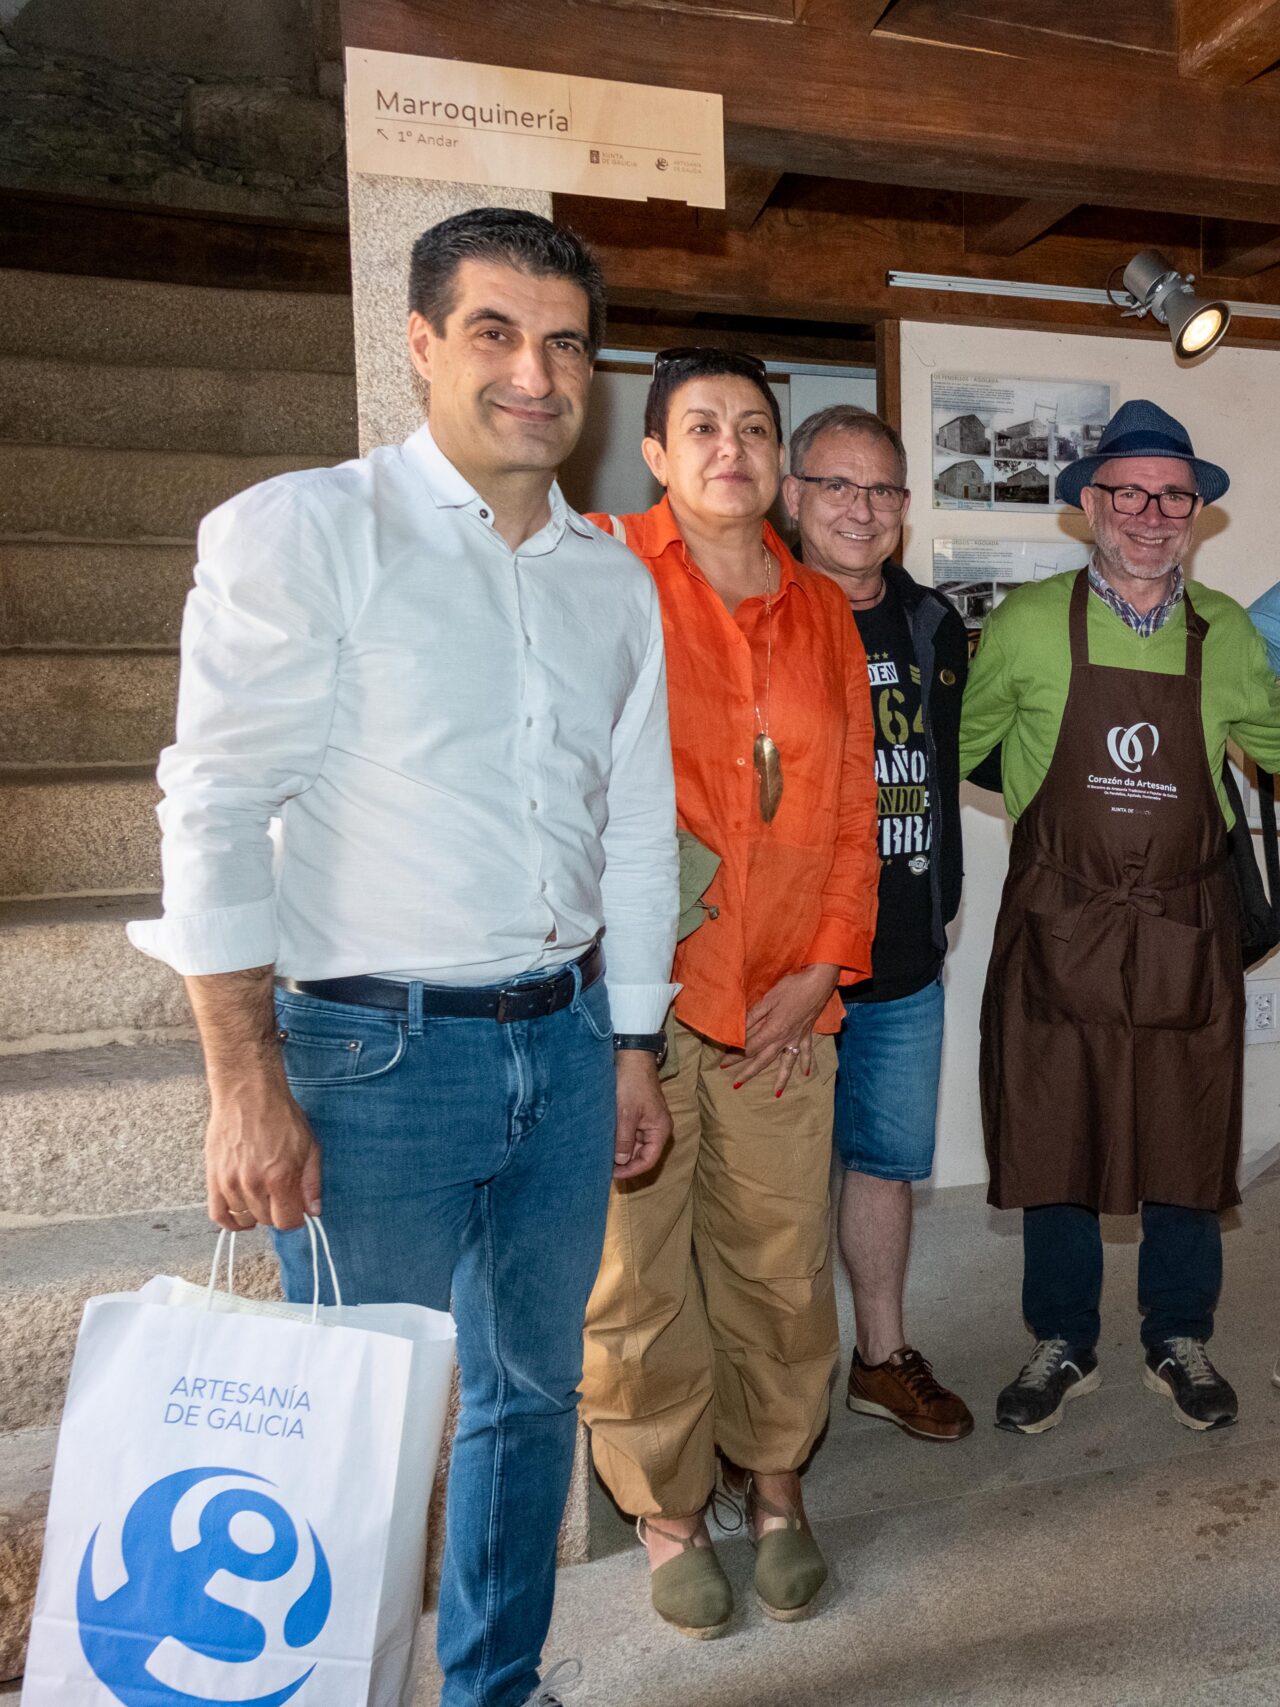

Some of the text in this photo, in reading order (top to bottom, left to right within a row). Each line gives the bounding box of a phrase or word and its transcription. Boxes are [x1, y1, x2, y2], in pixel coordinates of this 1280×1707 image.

[376, 89, 570, 131] Marroquinería
[417, 133, 459, 148] Andar
[1088, 775, 1176, 791] Corazón da Artesanía
[170, 1375, 311, 1412] ARTESANÍA
[164, 1403, 305, 1440] DE GALICIA
